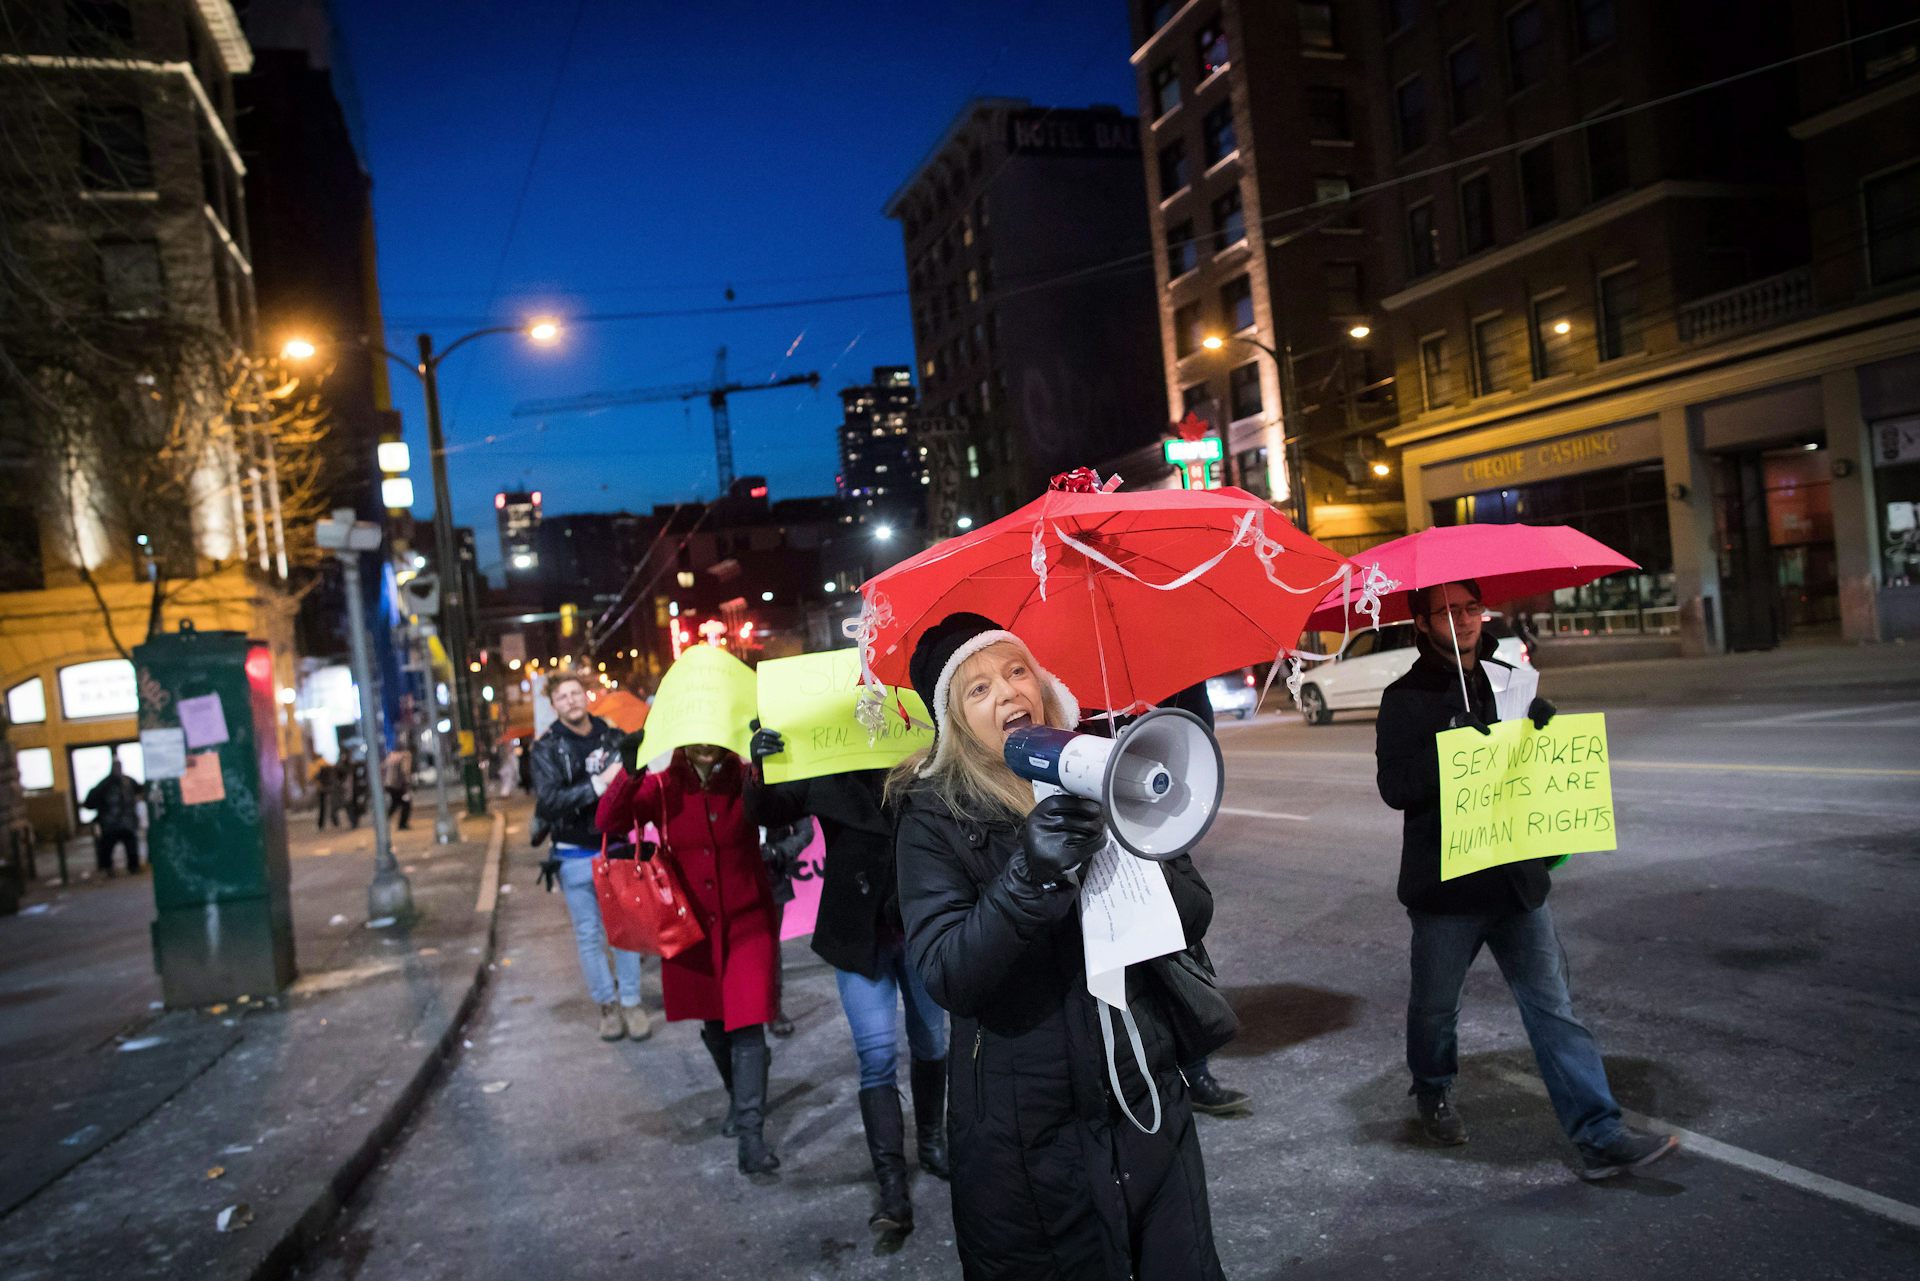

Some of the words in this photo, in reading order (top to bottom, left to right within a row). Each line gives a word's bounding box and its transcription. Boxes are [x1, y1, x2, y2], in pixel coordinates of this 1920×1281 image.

[1463, 452, 1525, 483] CHEQUE
[1538, 432, 1617, 467] CASHING
[812, 724, 857, 751] REAL
[876, 718, 927, 743] WORK
[1452, 745, 1497, 780] SEX
[1507, 735, 1604, 770] WORKER
[1456, 777, 1531, 816] RIGHTS
[1545, 771, 1600, 794] ARE
[1449, 817, 1513, 862] HUMAN
